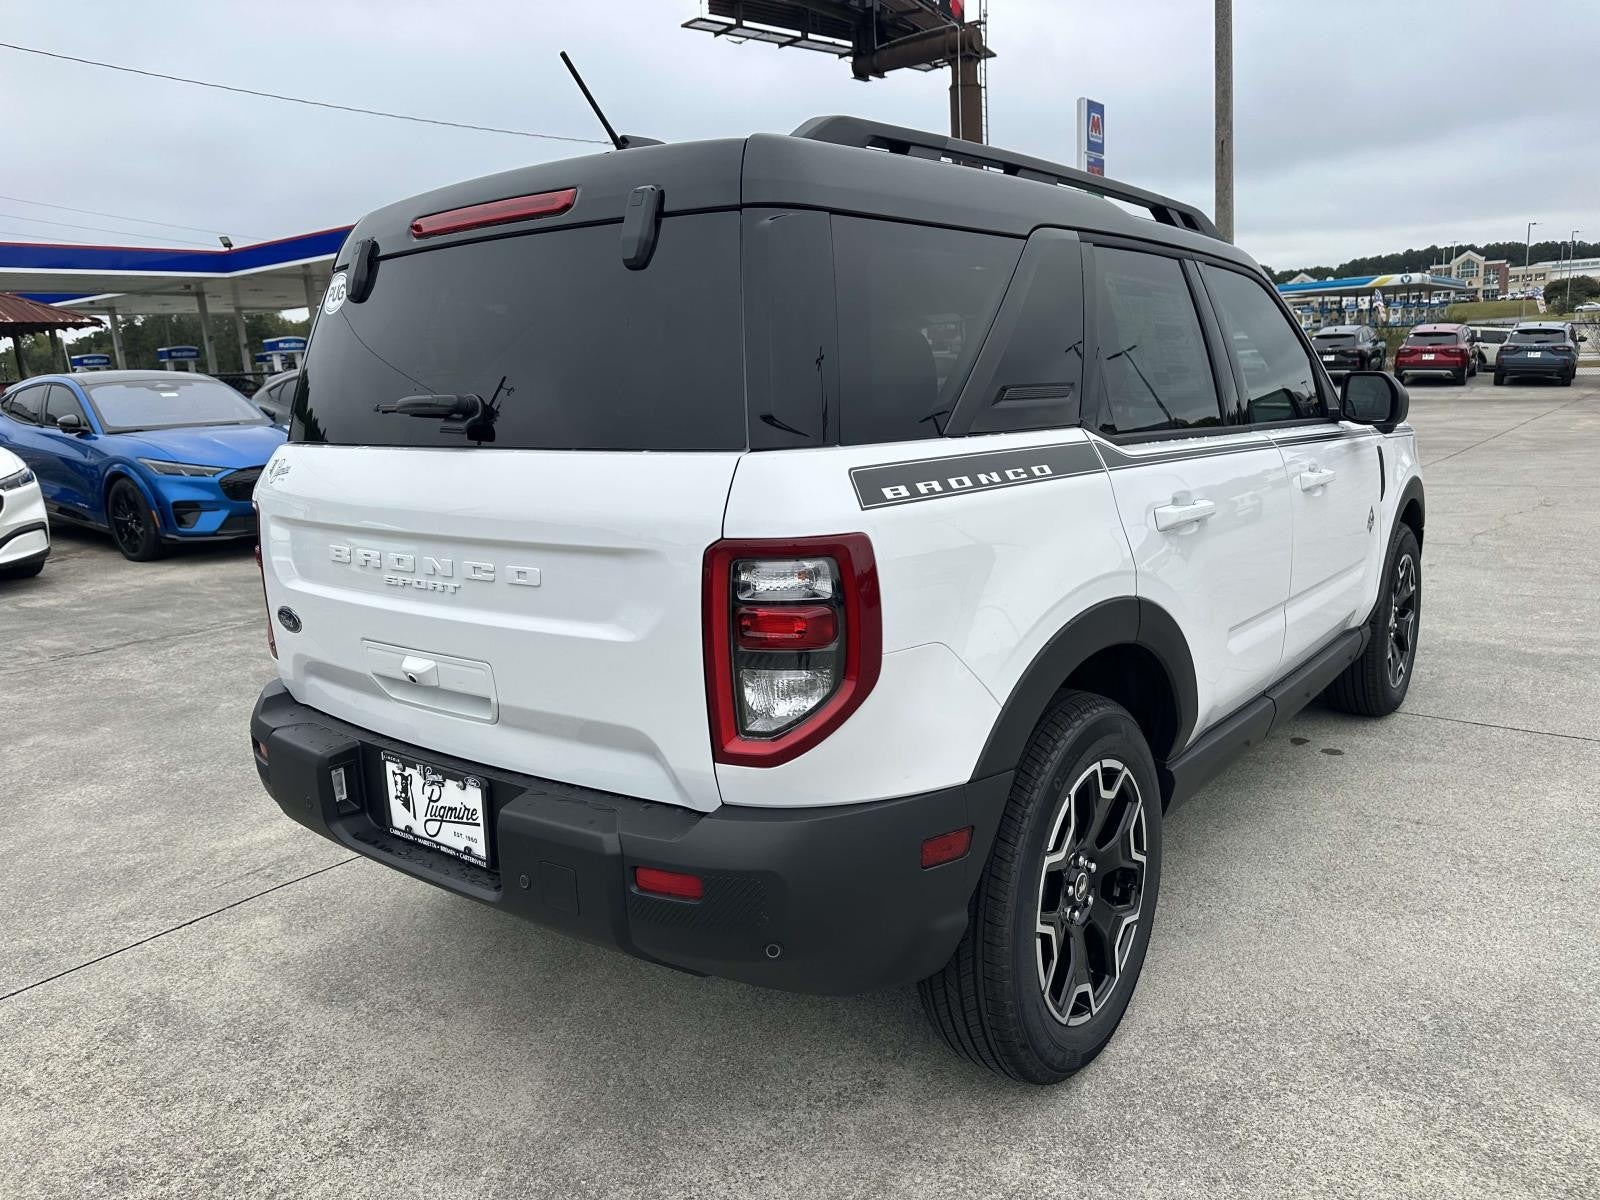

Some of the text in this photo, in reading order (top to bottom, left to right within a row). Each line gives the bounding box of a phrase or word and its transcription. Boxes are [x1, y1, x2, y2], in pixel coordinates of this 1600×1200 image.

[327, 283, 346, 302] PUG
[881, 464, 1053, 499] BRONCO
[329, 545, 541, 586] BRONCO
[384, 574, 461, 594] SPORT
[422, 781, 480, 838] Pugmire
[453, 830, 465, 840] EST.
